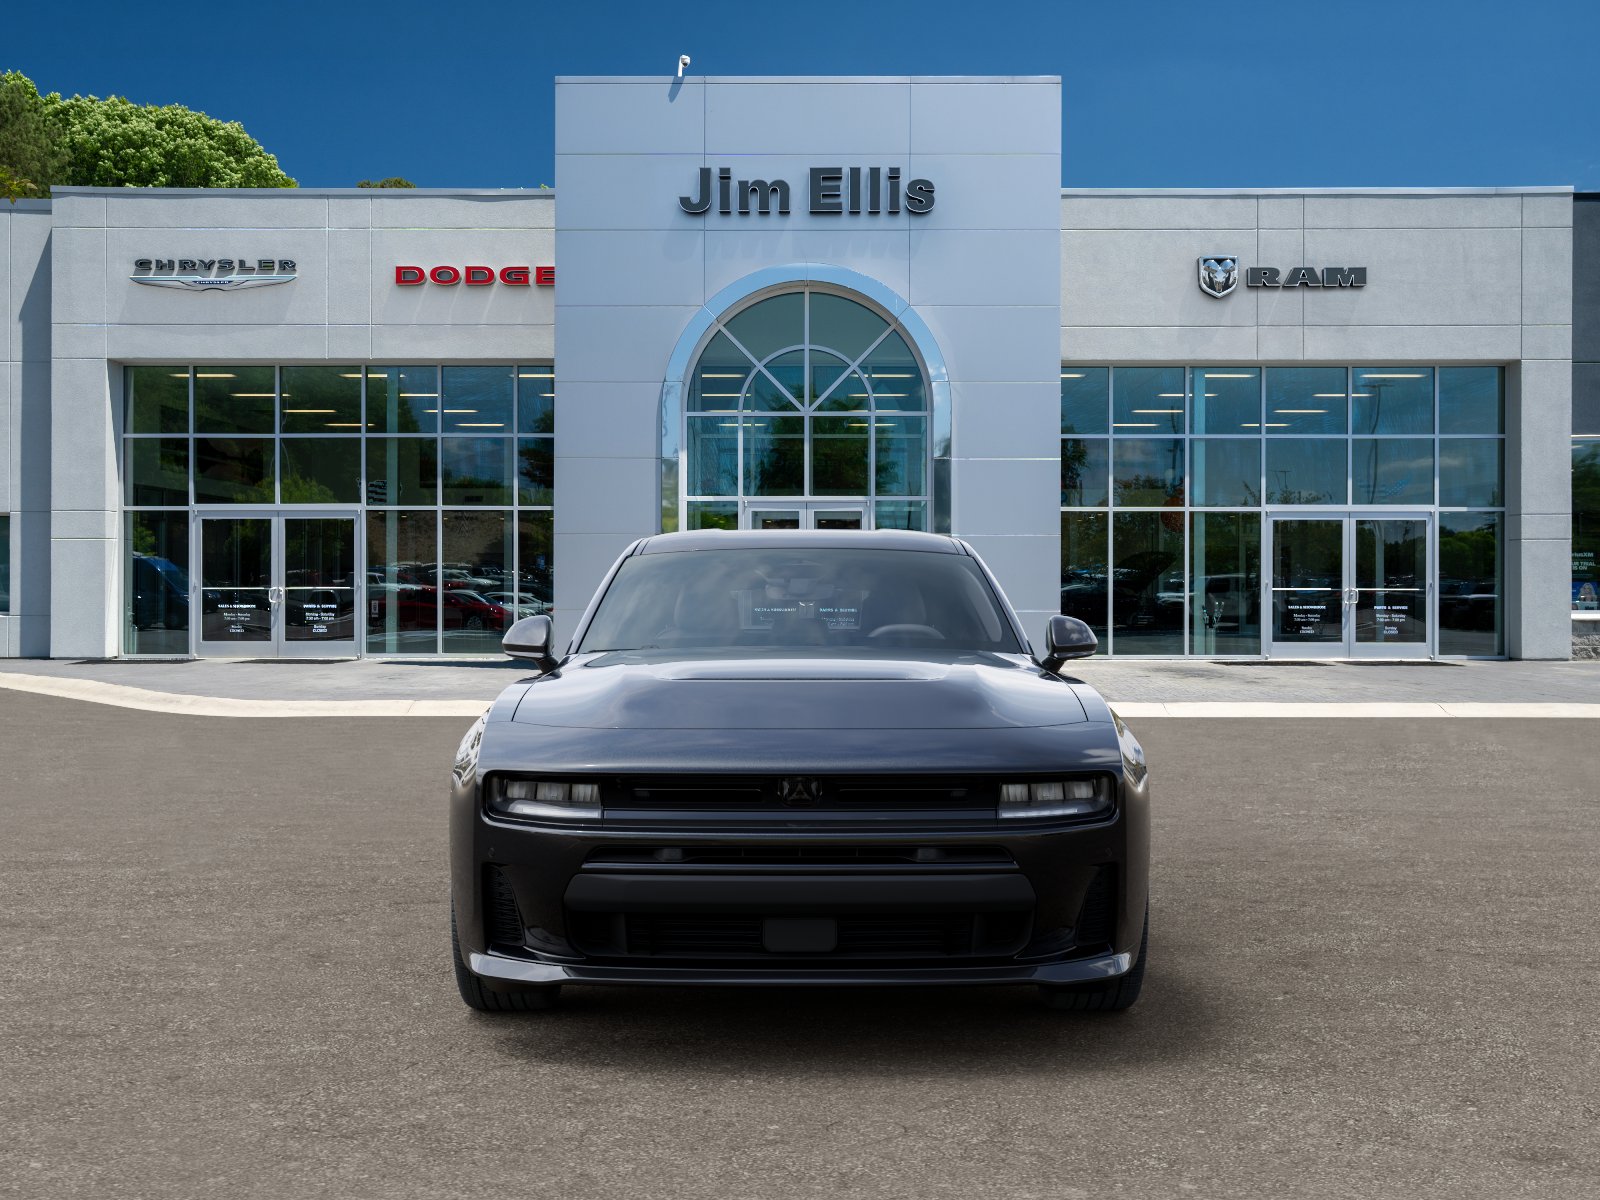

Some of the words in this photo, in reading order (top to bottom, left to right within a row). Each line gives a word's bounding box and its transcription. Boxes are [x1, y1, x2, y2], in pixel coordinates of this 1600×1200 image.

[679, 167, 791, 214] Jim
[809, 167, 936, 214] Ellis
[134, 258, 298, 271] CHRYSLER
[396, 265, 556, 287] DODGE
[1247, 267, 1368, 288] RAM
